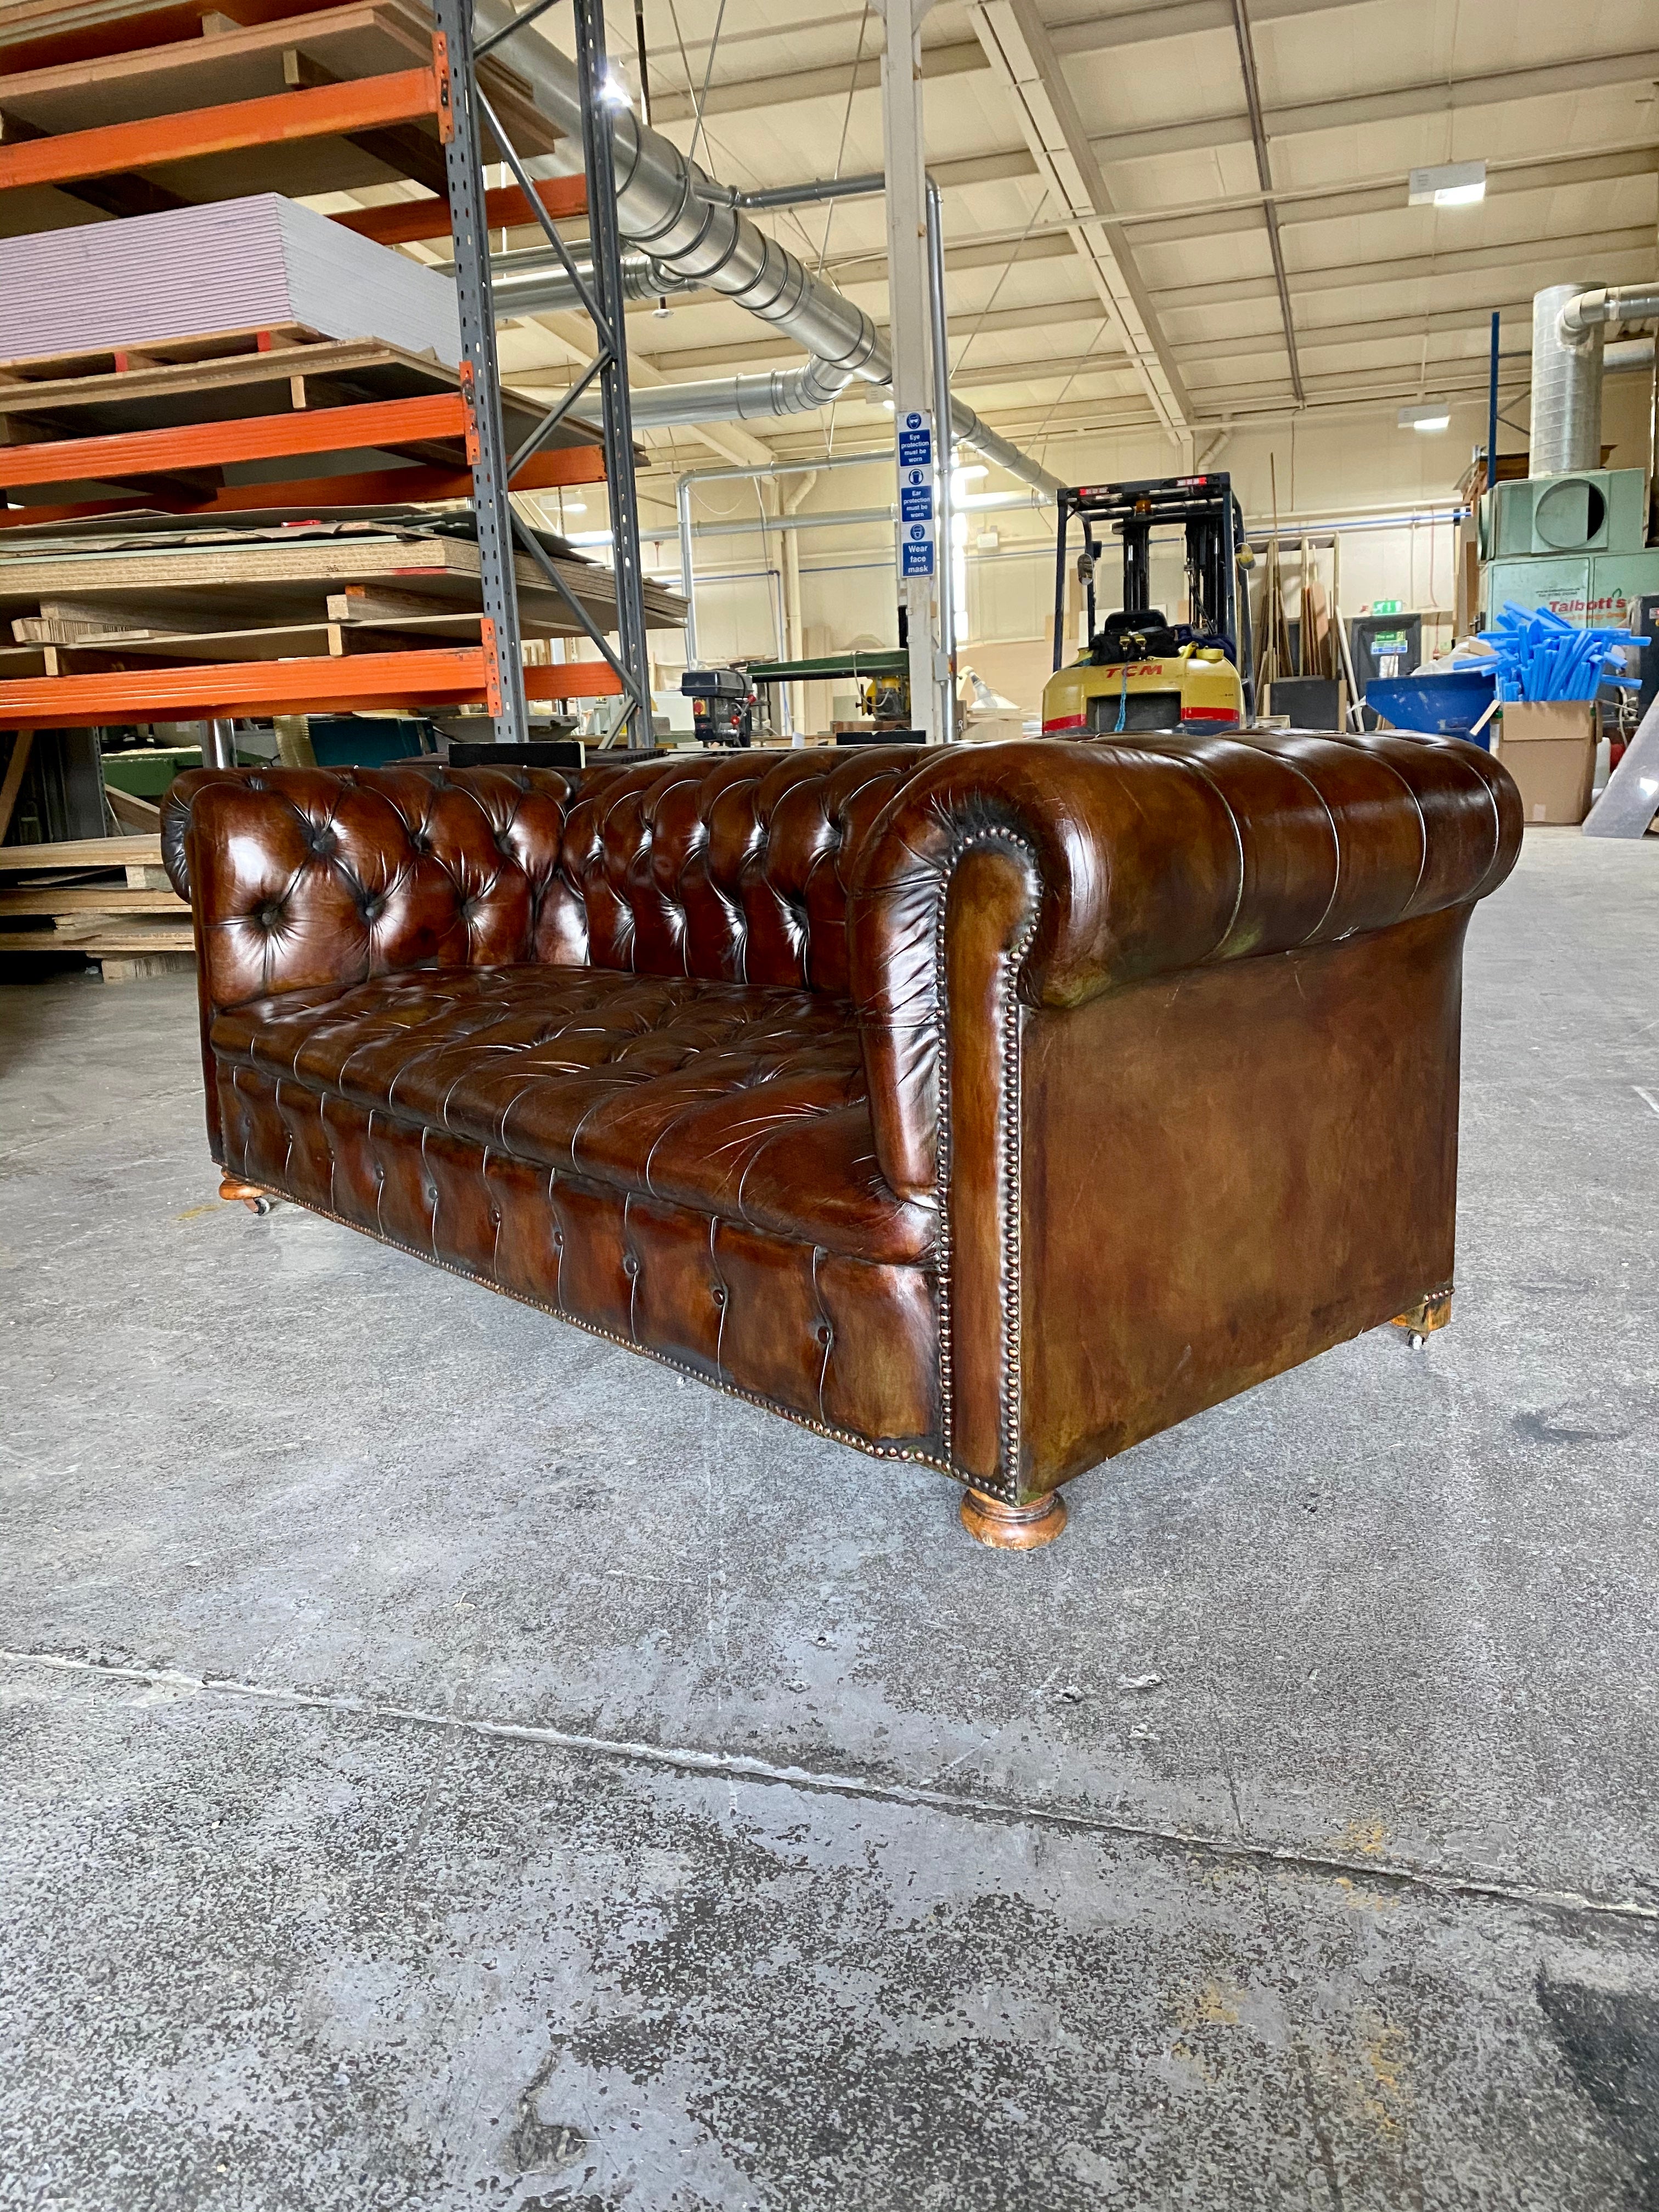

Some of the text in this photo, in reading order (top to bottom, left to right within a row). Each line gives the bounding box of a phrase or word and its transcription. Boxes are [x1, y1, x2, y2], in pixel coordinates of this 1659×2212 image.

[901, 441, 929, 449] protection
[904, 497, 930, 505] protection
[1106, 665, 1163, 679] TCM
